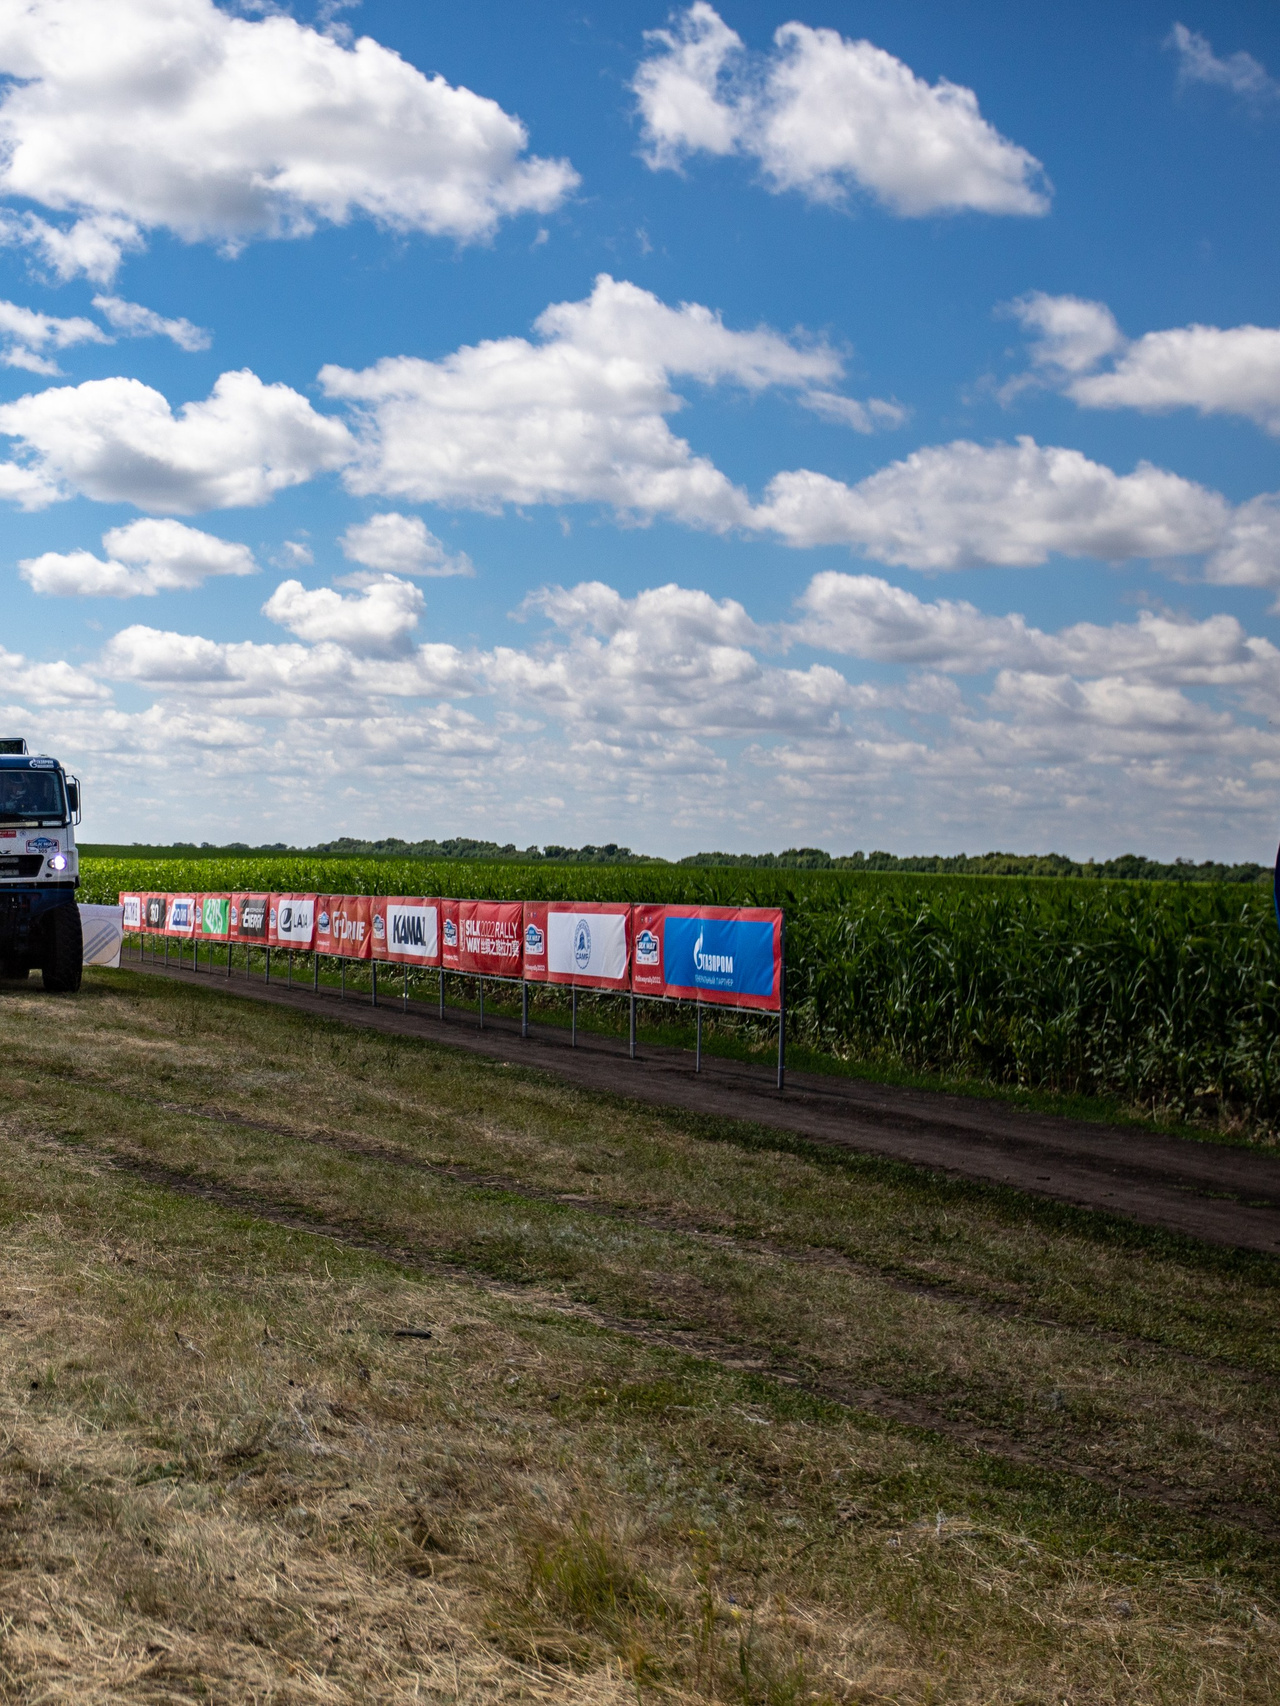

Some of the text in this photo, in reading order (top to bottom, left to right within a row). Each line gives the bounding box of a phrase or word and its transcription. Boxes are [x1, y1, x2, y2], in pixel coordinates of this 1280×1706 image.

[465, 919, 481, 936] SILK
[495, 921, 519, 939] RALLY
[466, 937, 481, 953] WAY
